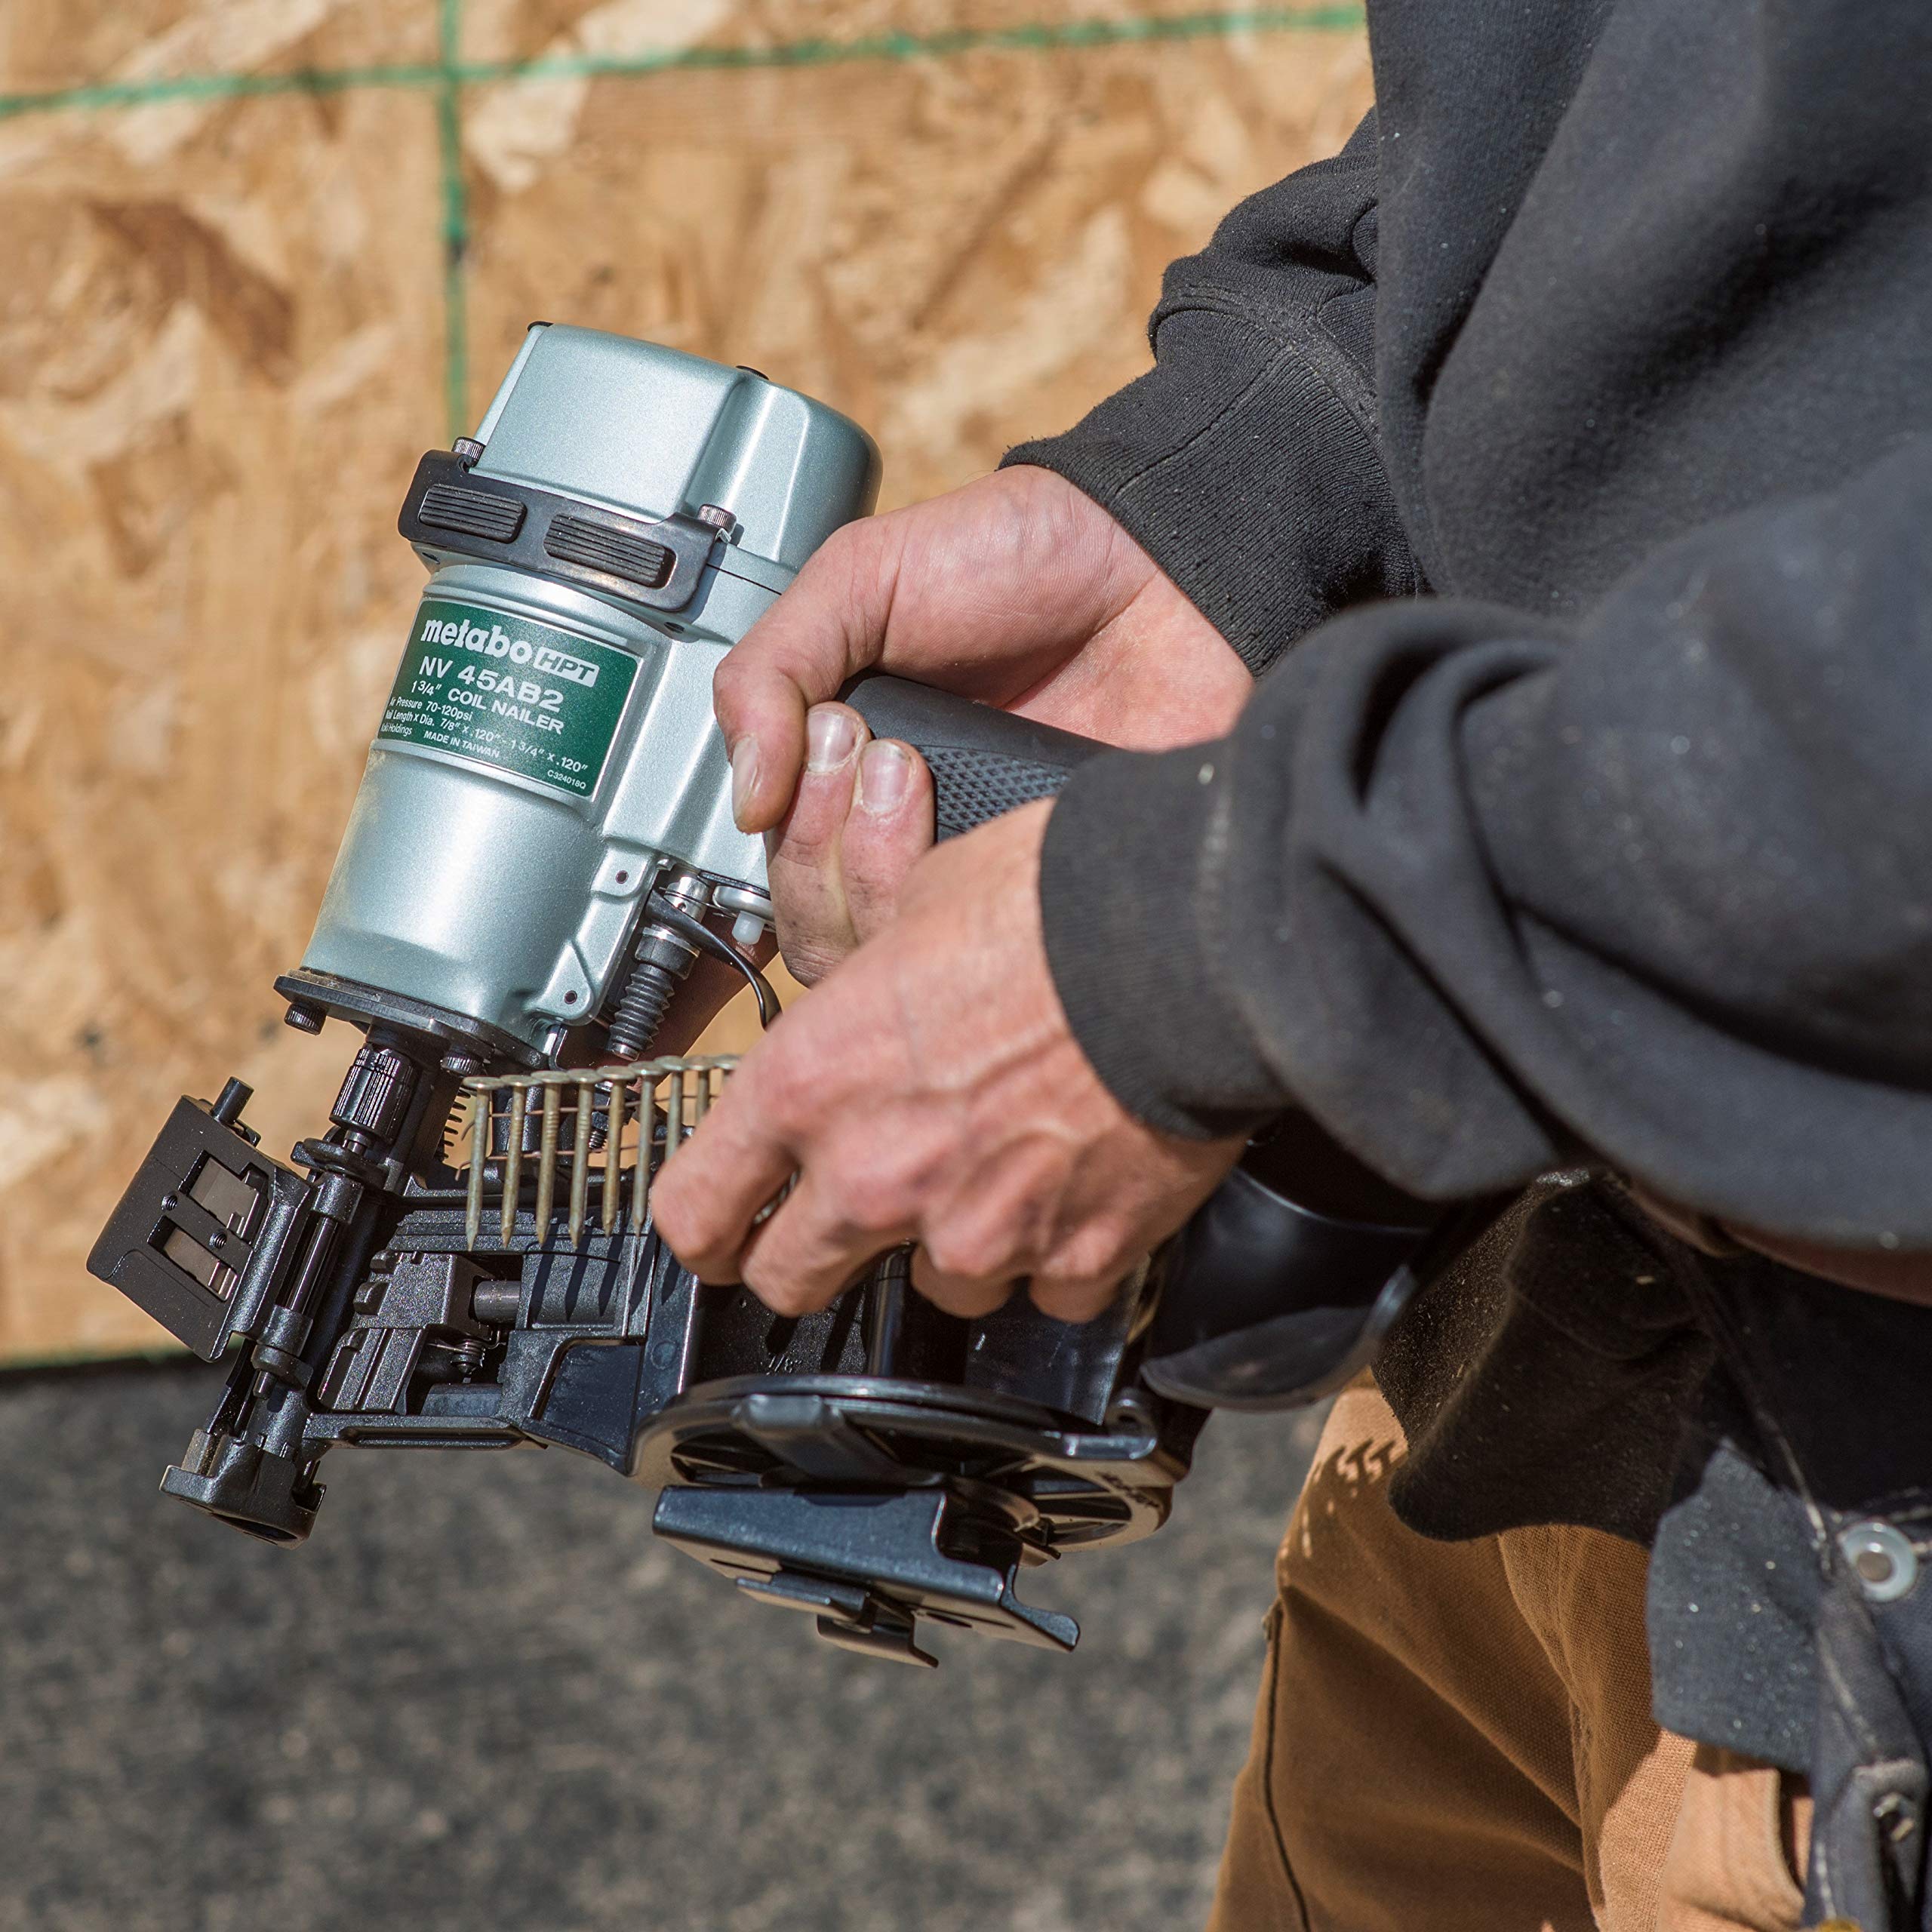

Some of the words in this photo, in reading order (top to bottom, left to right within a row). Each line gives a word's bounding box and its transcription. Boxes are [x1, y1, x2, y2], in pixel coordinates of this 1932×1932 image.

[420, 619, 532, 664] metabo
[535, 649, 596, 683] HPT
[419, 656, 453, 678] NV
[457, 665, 564, 712] 45AB2
[393, 709, 413, 722] Length
[420, 713, 435, 727] Dia.
[397, 697, 423, 709] Pressure
[426, 701, 473, 721] 70-120psi
[448, 688, 487, 710] COIL
[491, 700, 565, 734] NAILER
[389, 723, 413, 737] Holdings
[423, 731, 449, 743] MADE
[450, 737, 460, 746] IN
[462, 740, 500, 758] TAIWAN
[547, 770, 586, 789] C324018Q
